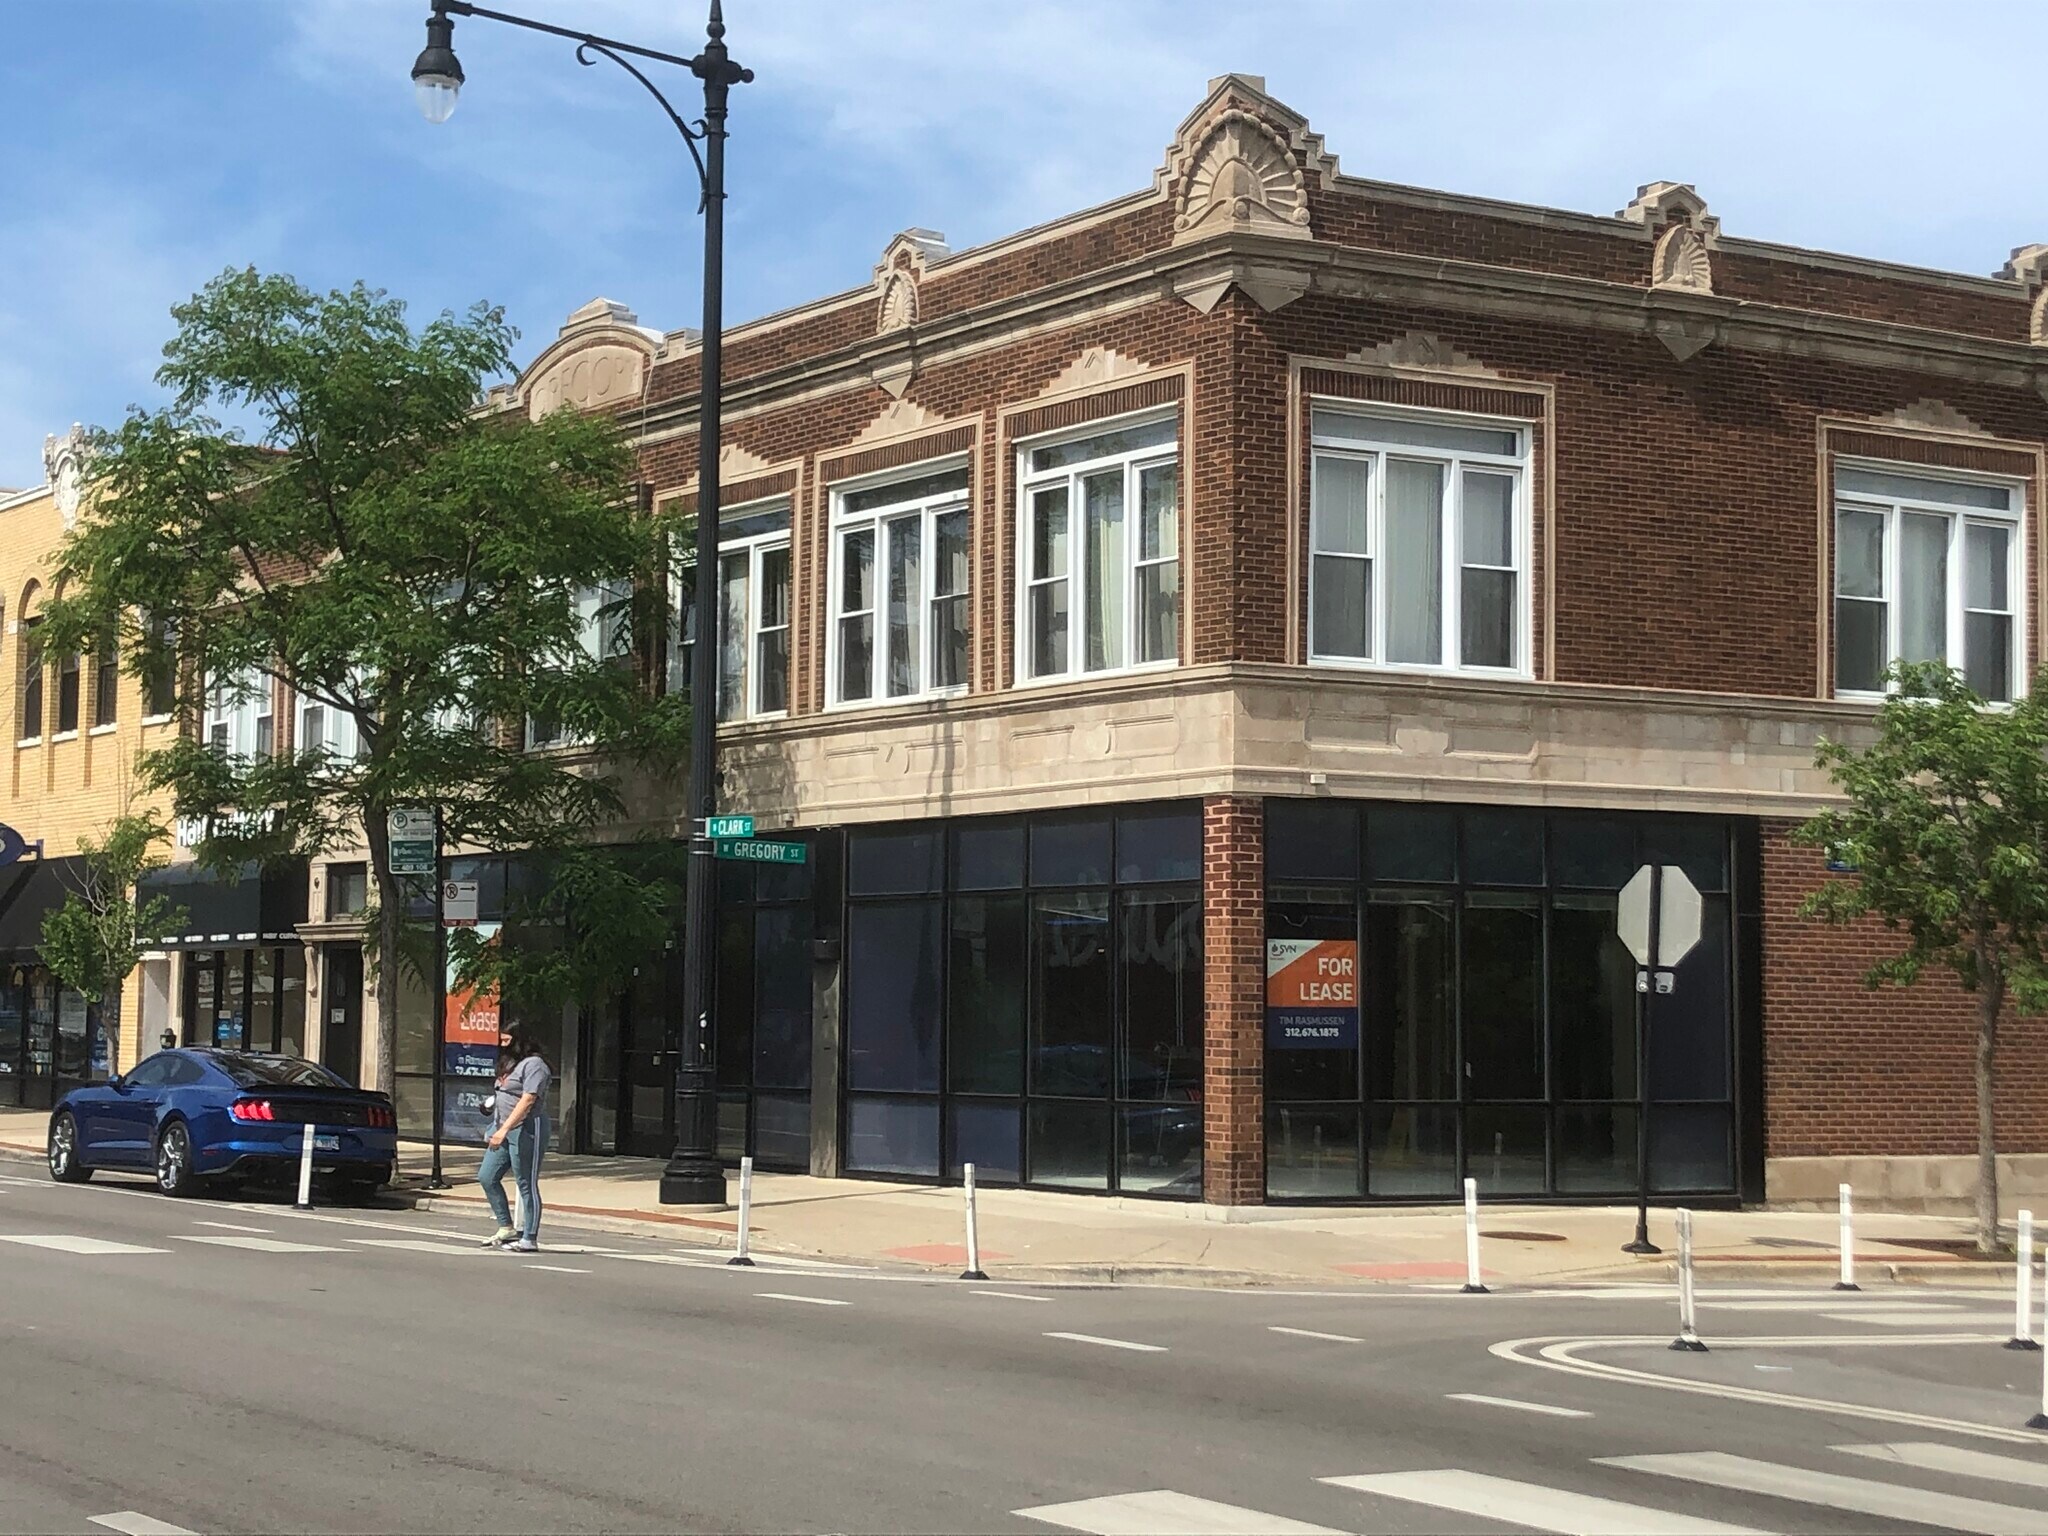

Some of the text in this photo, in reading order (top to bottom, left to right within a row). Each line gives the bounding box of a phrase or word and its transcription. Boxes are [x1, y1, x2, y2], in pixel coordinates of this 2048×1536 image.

[718, 819, 744, 835] CLARK
[745, 823, 752, 832] ST
[734, 842, 786, 860] GREGORY
[791, 849, 799, 857] ST
[1279, 944, 1297, 954] SVN
[1318, 957, 1353, 976] FOR
[1299, 982, 1353, 1001] LEASE
[1279, 1016, 1345, 1025] TIM RASMUSSEN
